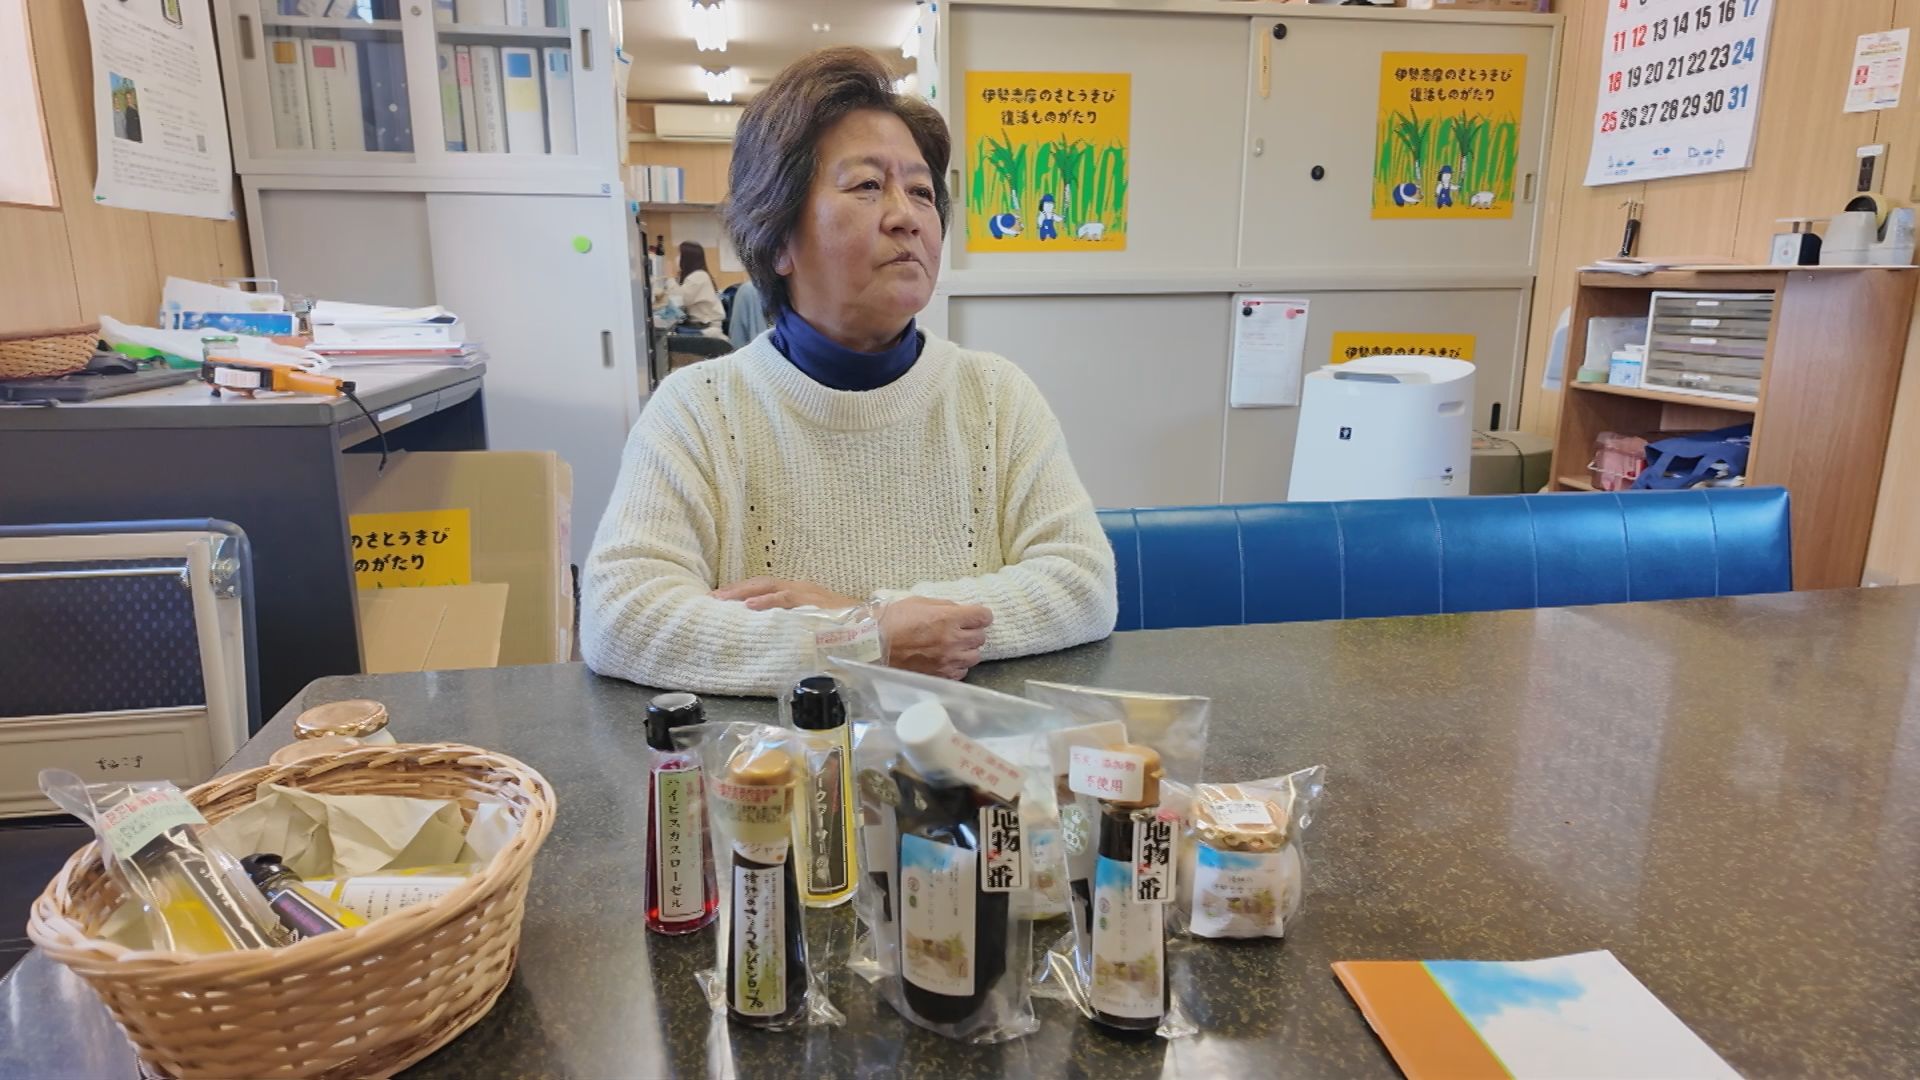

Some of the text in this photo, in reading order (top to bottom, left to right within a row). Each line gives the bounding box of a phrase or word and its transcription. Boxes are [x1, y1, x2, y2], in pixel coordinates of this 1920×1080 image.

[1614, 0, 1759, 52] 11 12 13 14 15 16 17
[1609, 38, 1756, 93] 18 19 20 21 22 23 24
[1395, 67, 1513, 83] 伊勢志摩のさとうきび
[982, 87, 1117, 104] 伊勢志摩のさとうきび
[1410, 87, 1495, 102] 復活ものがたり
[1001, 109, 1097, 125] 復活ものがたり
[1601, 84, 1749, 133] 25 26 27 28 29 30 31
[354, 553, 425, 572] のがたり
